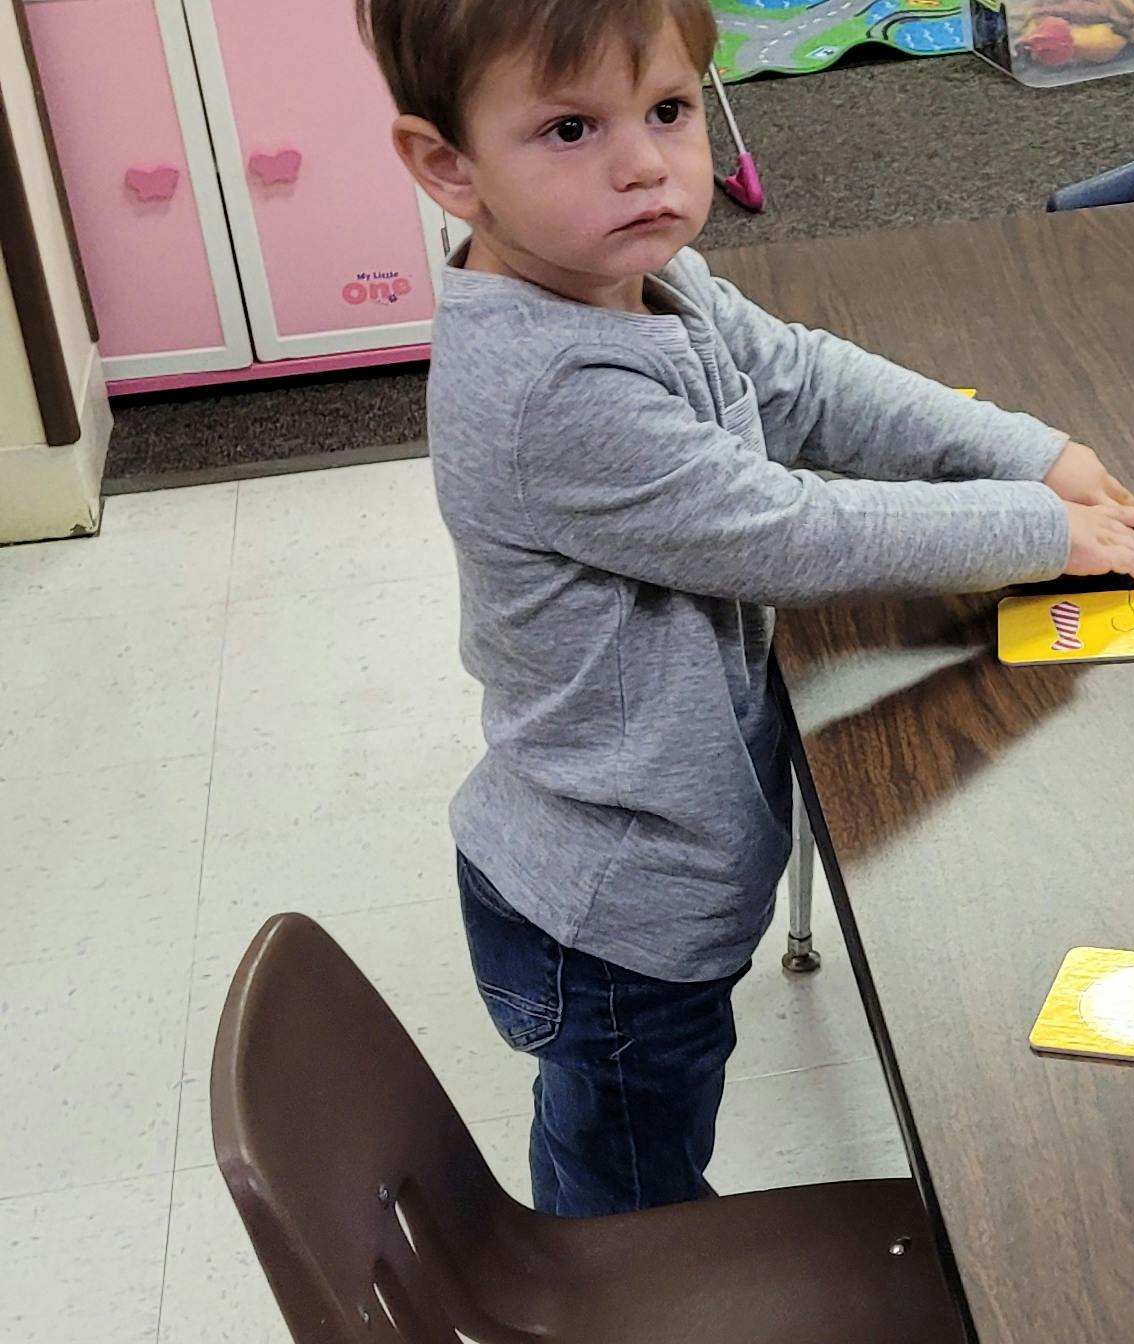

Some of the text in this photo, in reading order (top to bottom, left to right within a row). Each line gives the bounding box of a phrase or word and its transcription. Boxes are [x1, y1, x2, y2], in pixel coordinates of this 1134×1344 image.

[356, 271, 399, 281] My Little
[342, 278, 412, 305] One
